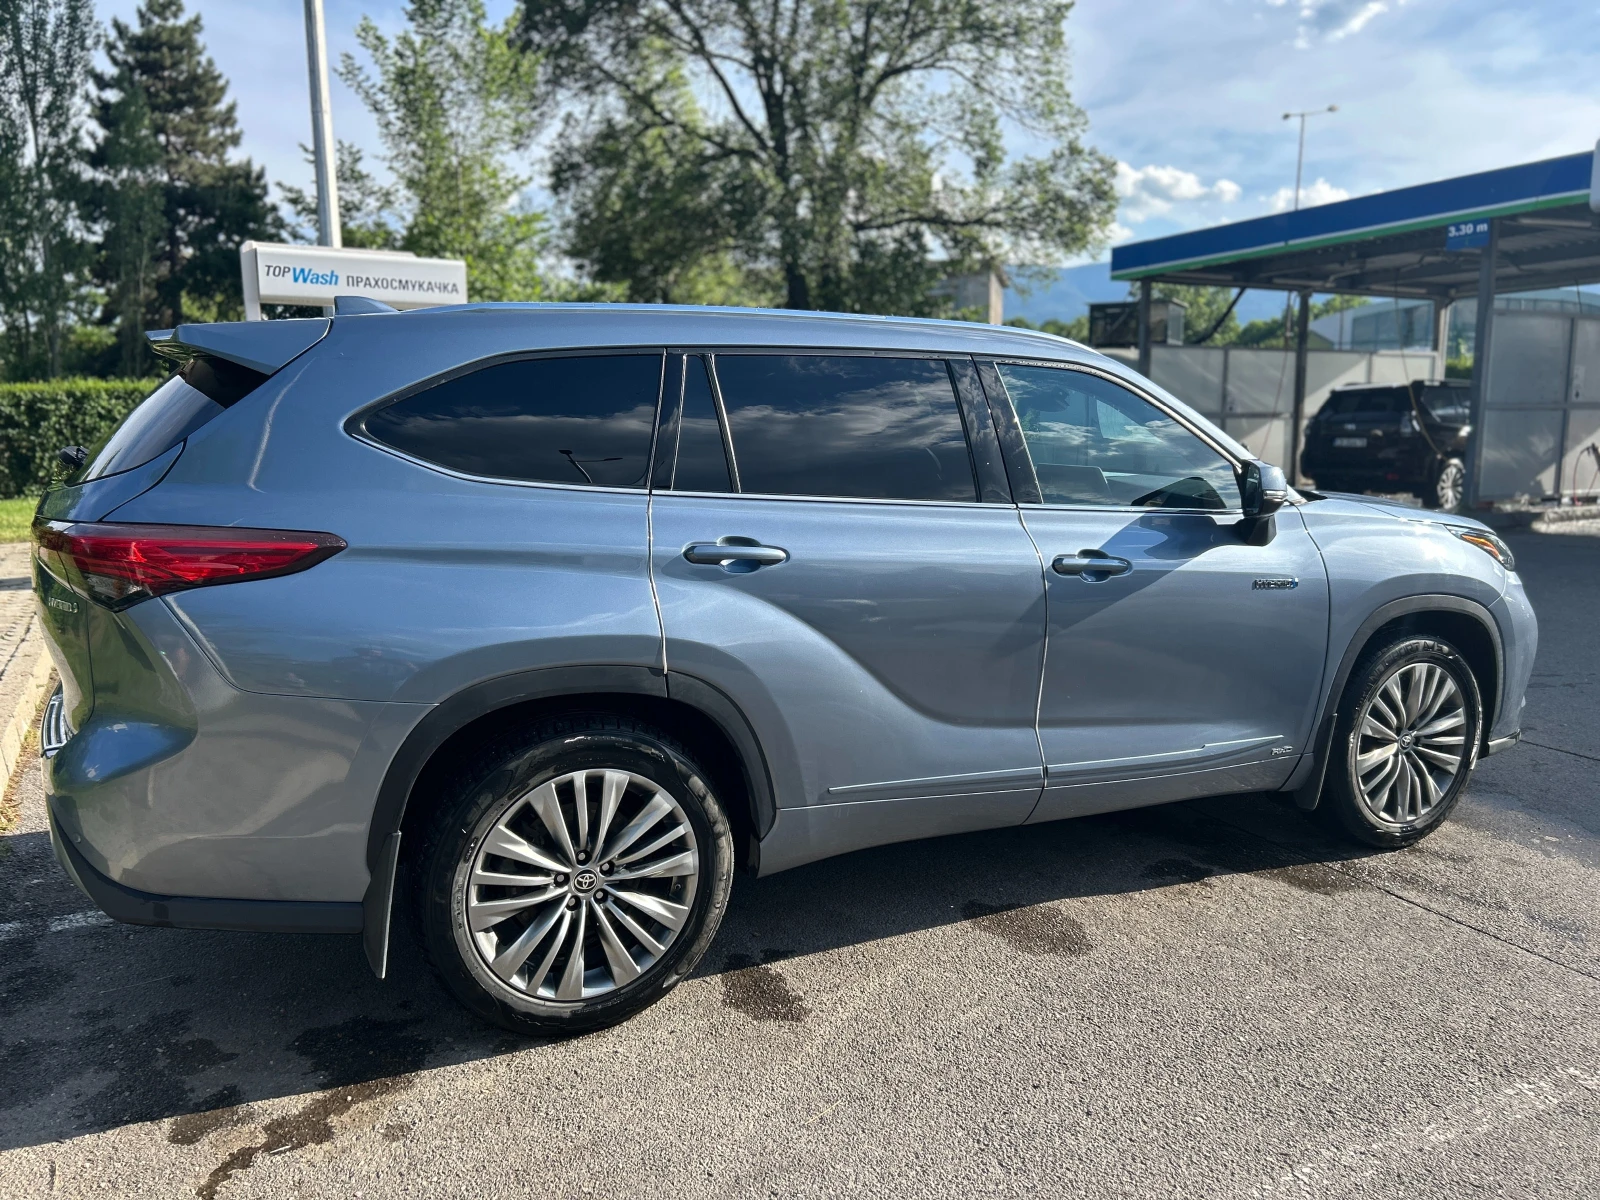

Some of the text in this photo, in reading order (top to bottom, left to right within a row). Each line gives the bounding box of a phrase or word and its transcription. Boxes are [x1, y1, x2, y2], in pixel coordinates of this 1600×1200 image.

[1448, 223, 1488, 237] 3.30 m
[346, 275, 459, 295] ПРАХОСМУКАЧКА
